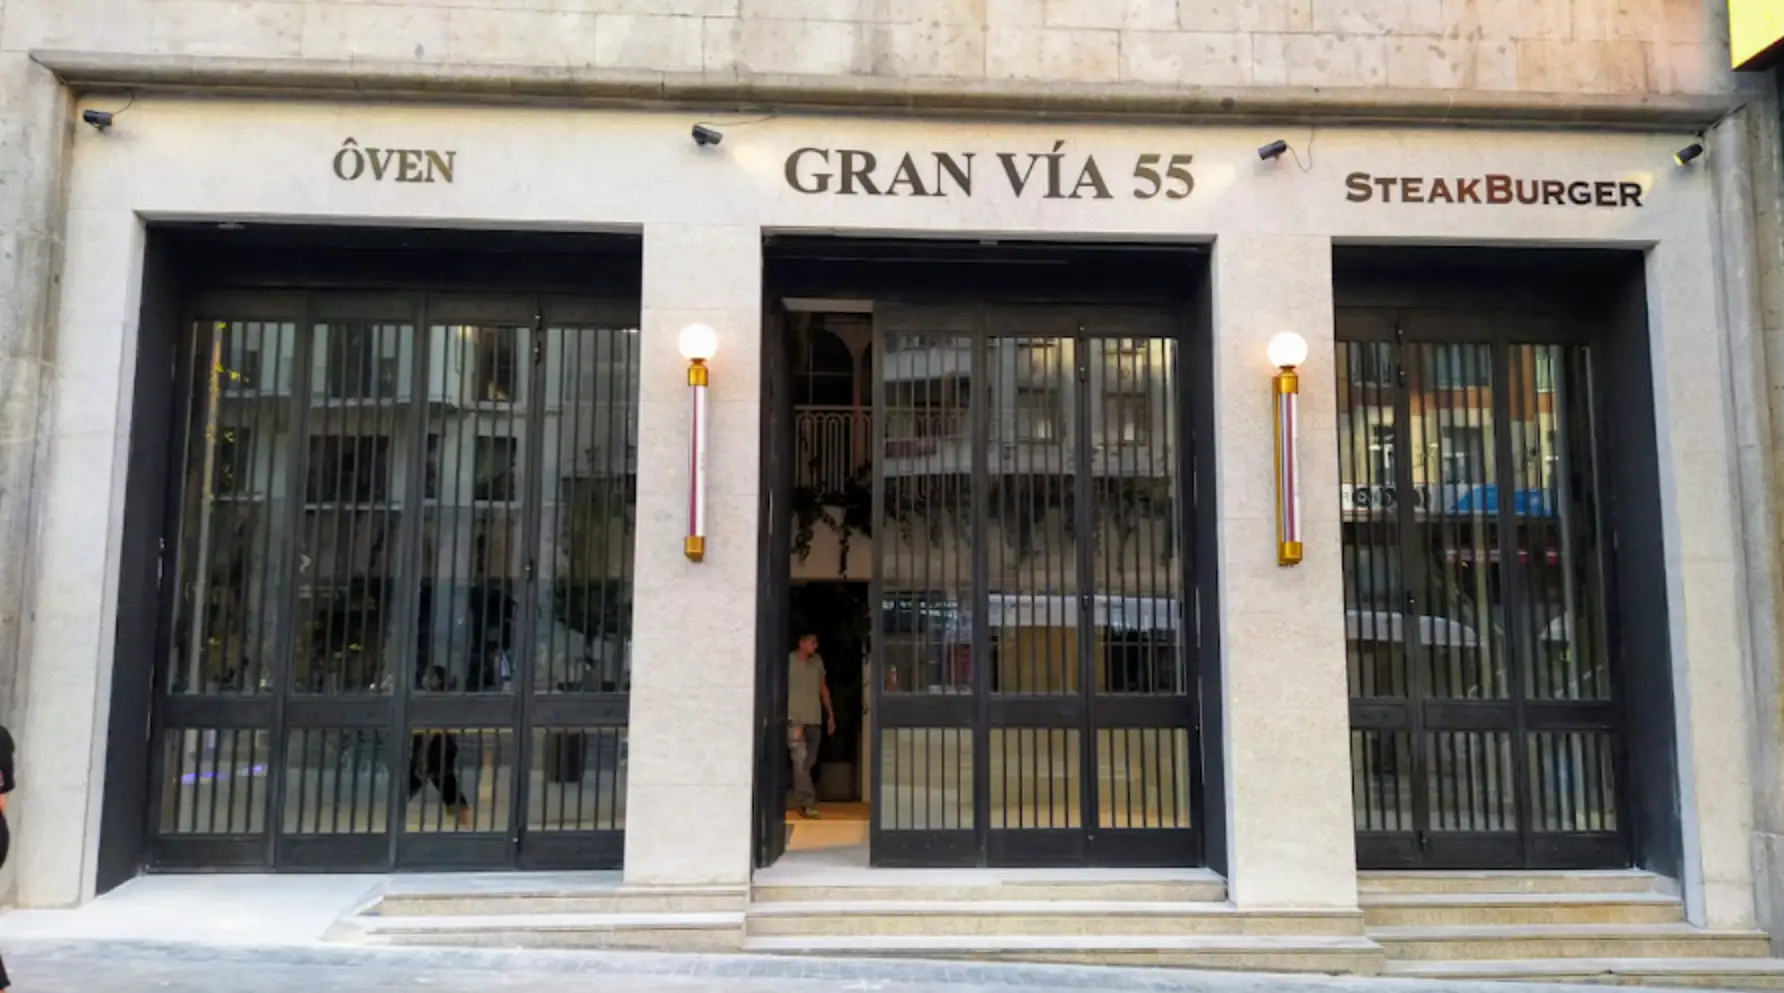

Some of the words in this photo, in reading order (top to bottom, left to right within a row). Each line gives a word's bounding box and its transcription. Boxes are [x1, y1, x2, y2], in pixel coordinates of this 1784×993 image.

[332, 136, 457, 183] ÔVEN
[784, 147, 976, 197] GRAN
[995, 139, 1114, 199] VÍA
[1133, 153, 1195, 199] 55
